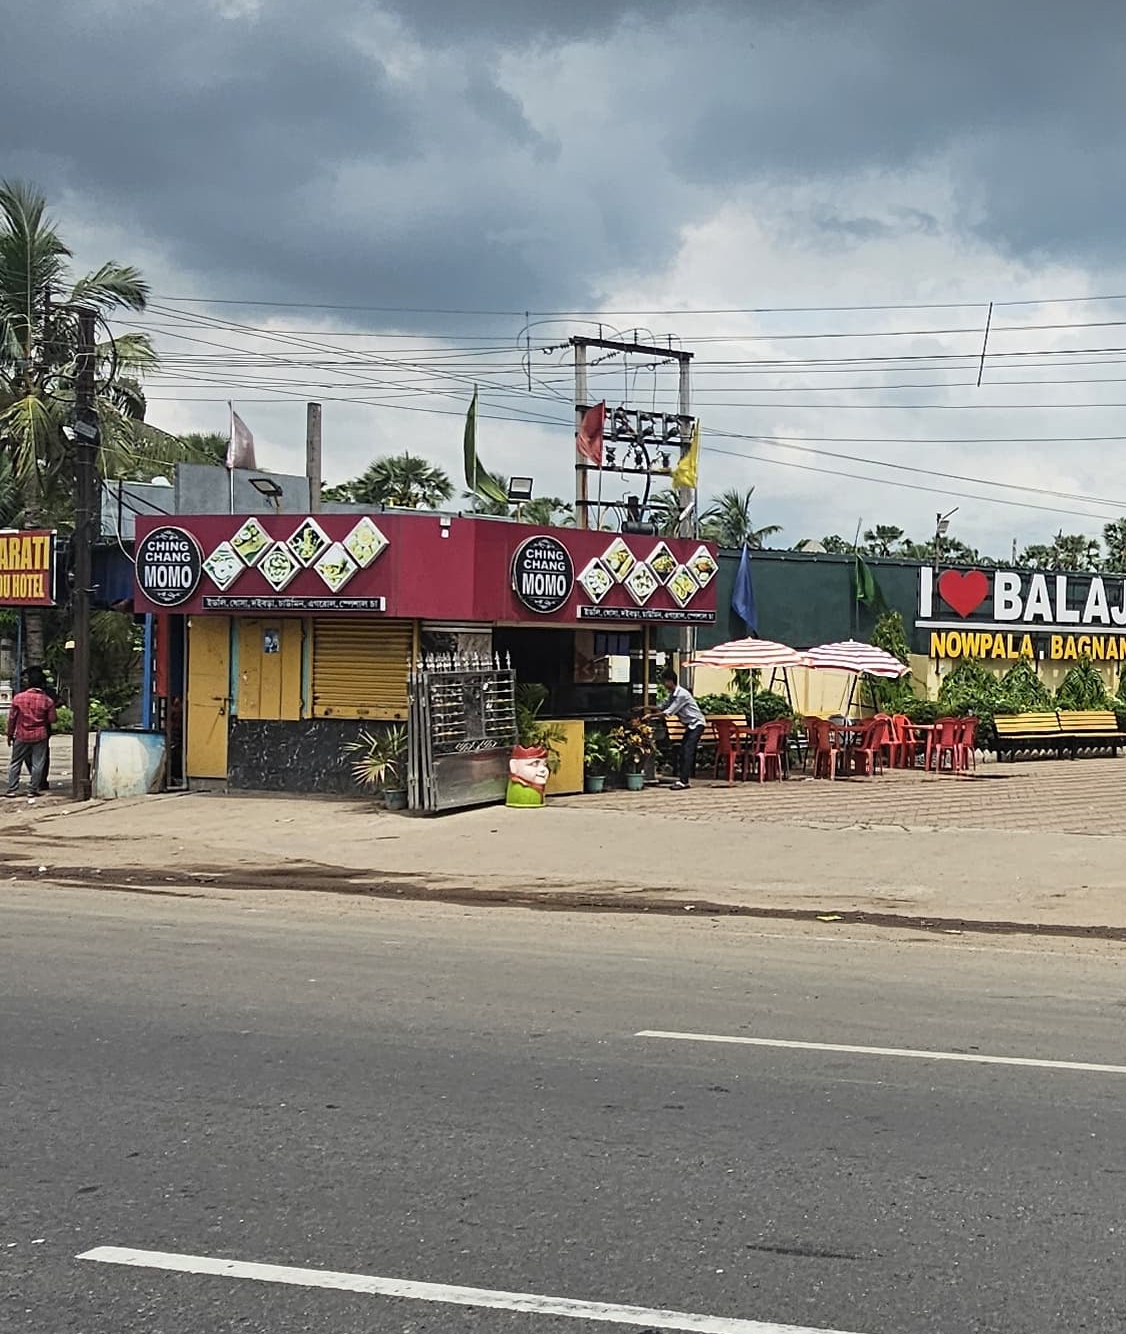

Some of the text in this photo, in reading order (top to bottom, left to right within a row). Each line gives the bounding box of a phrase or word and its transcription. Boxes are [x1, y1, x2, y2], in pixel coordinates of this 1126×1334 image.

[145, 552, 191, 563] CHANG
[147, 541, 189, 552] CHING
[525, 549, 564, 561] CHING
[144, 565, 192, 588] MOMO
[523, 559, 566, 571] CHANG
[12, 574, 45, 598] HOTEL
[522, 573, 567, 596] MOMO
[920, 566, 933, 618] I
[930, 631, 1034, 659] NOWPALA
